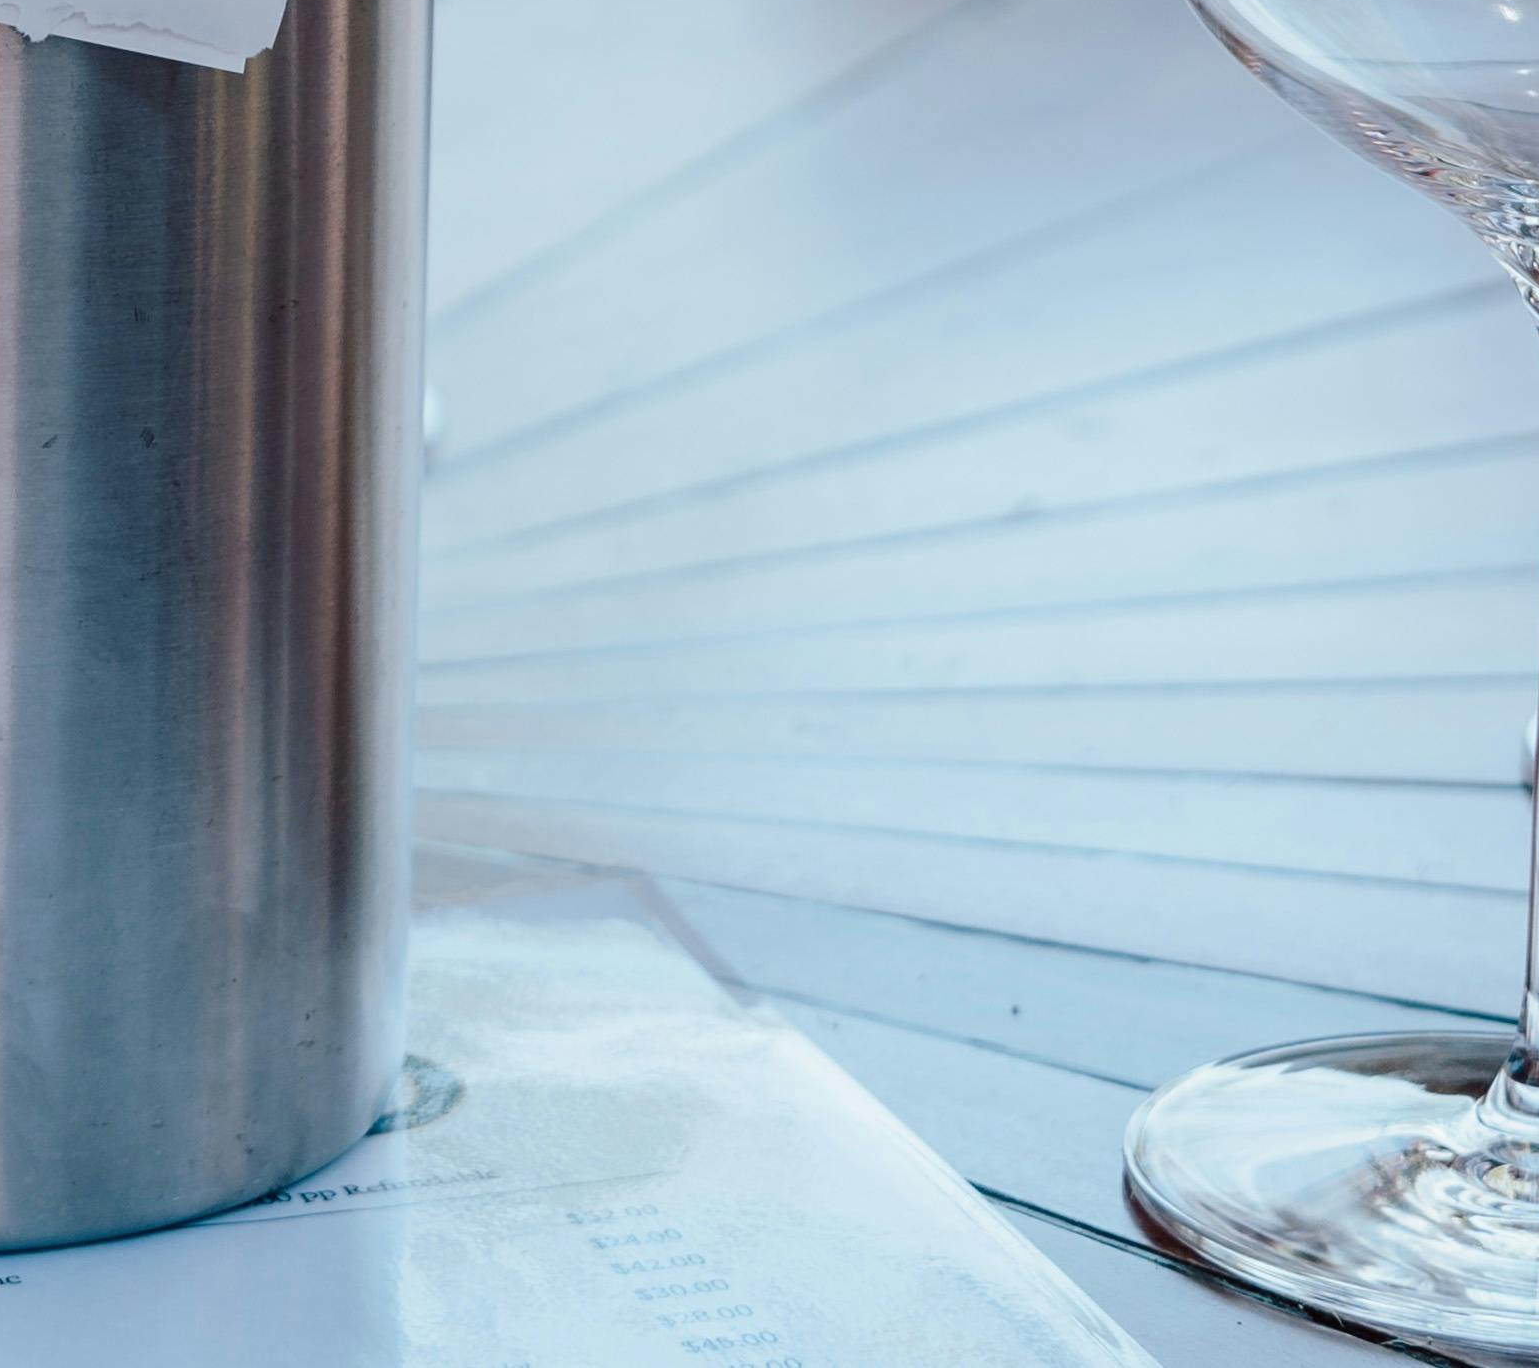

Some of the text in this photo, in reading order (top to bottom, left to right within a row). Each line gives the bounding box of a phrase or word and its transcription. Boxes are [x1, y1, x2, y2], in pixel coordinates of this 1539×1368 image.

[299, 1188, 337, 1204] pp
[610, 1252, 706, 1275] $42.00
[634, 1278, 730, 1301] $30.00
